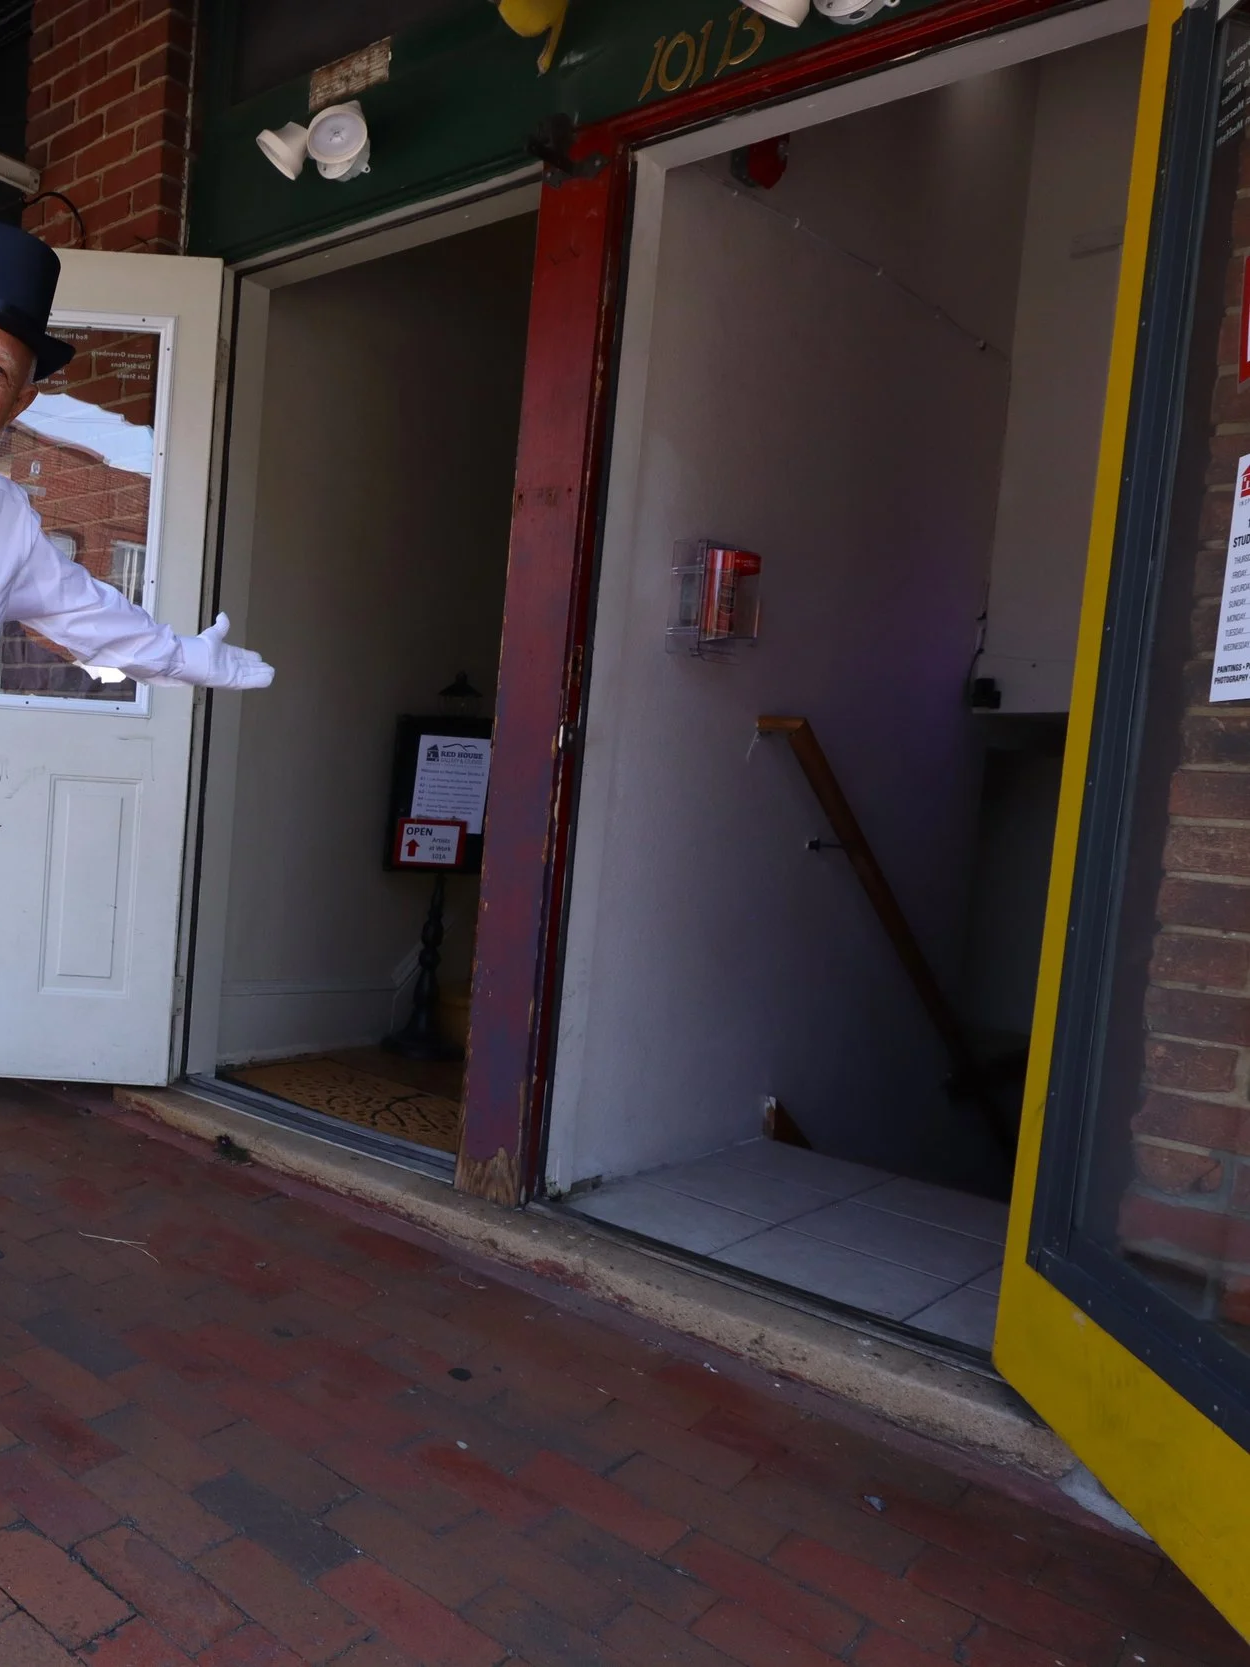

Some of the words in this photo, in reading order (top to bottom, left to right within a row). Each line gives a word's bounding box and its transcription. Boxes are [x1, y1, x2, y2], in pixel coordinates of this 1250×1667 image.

[1228, 598, 1246, 609] SUNDAY
[1226, 612, 1246, 623] MONDAY
[1225, 627, 1245, 638] TUESDAY
[457, 751, 484, 760] HOUSE
[406, 826, 433, 836] OPEN
